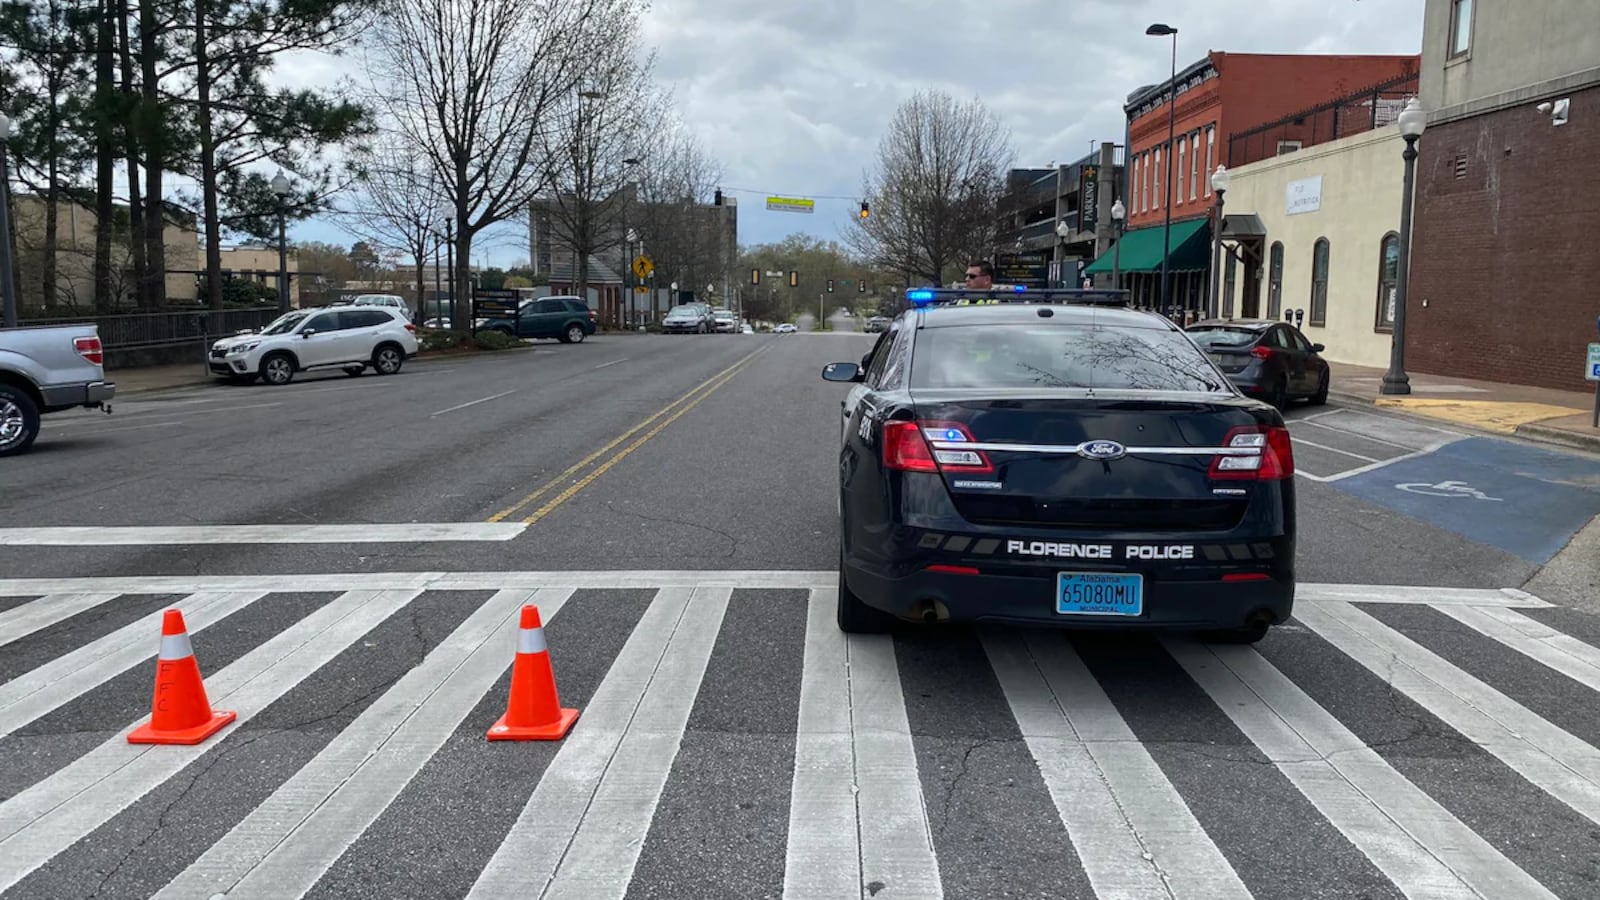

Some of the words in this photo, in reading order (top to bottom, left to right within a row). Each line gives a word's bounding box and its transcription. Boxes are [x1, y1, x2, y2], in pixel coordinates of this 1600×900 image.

[1084, 181, 1095, 221] PARKING
[1007, 540, 1112, 558] FLORENCE
[1126, 545, 1194, 559] POLICE
[1080, 574, 1120, 583] Alabama
[1062, 584, 1136, 605] 65080MU
